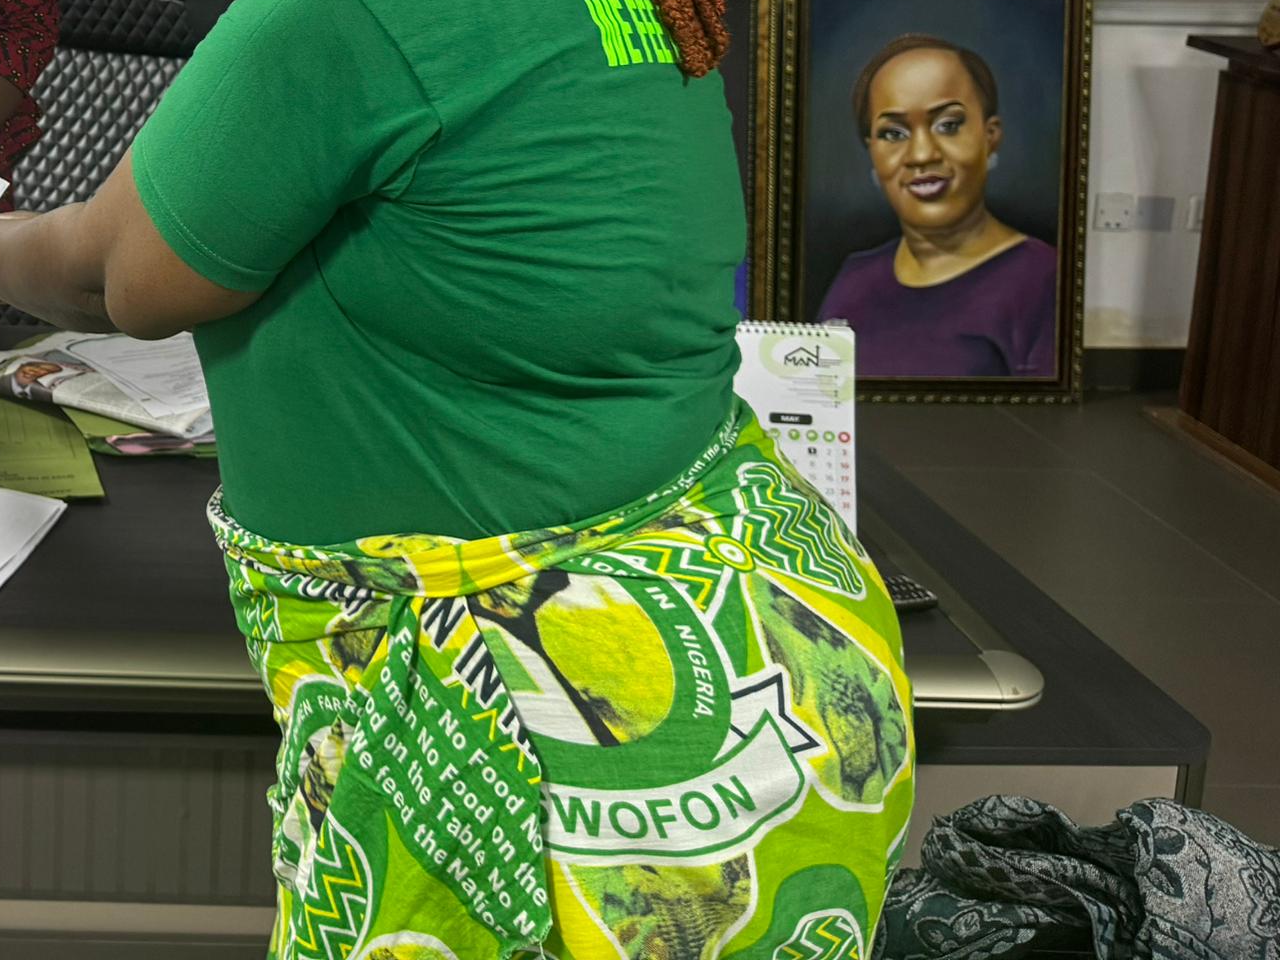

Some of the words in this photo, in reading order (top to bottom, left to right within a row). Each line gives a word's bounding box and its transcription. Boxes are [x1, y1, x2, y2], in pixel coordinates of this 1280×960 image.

[780, 415, 801, 423] MAY
[645, 586, 676, 610] IN
[352, 721, 374, 769] We
[375, 765, 416, 826] feed
[414, 823, 448, 865] the
[447, 857, 511, 939] Nation
[384, 733, 408, 764] on
[408, 760, 432, 805] the
[436, 797, 486, 867] Table
[488, 867, 512, 908] No
[417, 726, 439, 766] No
[439, 763, 494, 824] Food
[492, 825, 516, 863] on
[514, 862, 548, 907] the
[438, 709, 466, 750] No
[469, 748, 526, 815] Food
[520, 813, 544, 853] No
